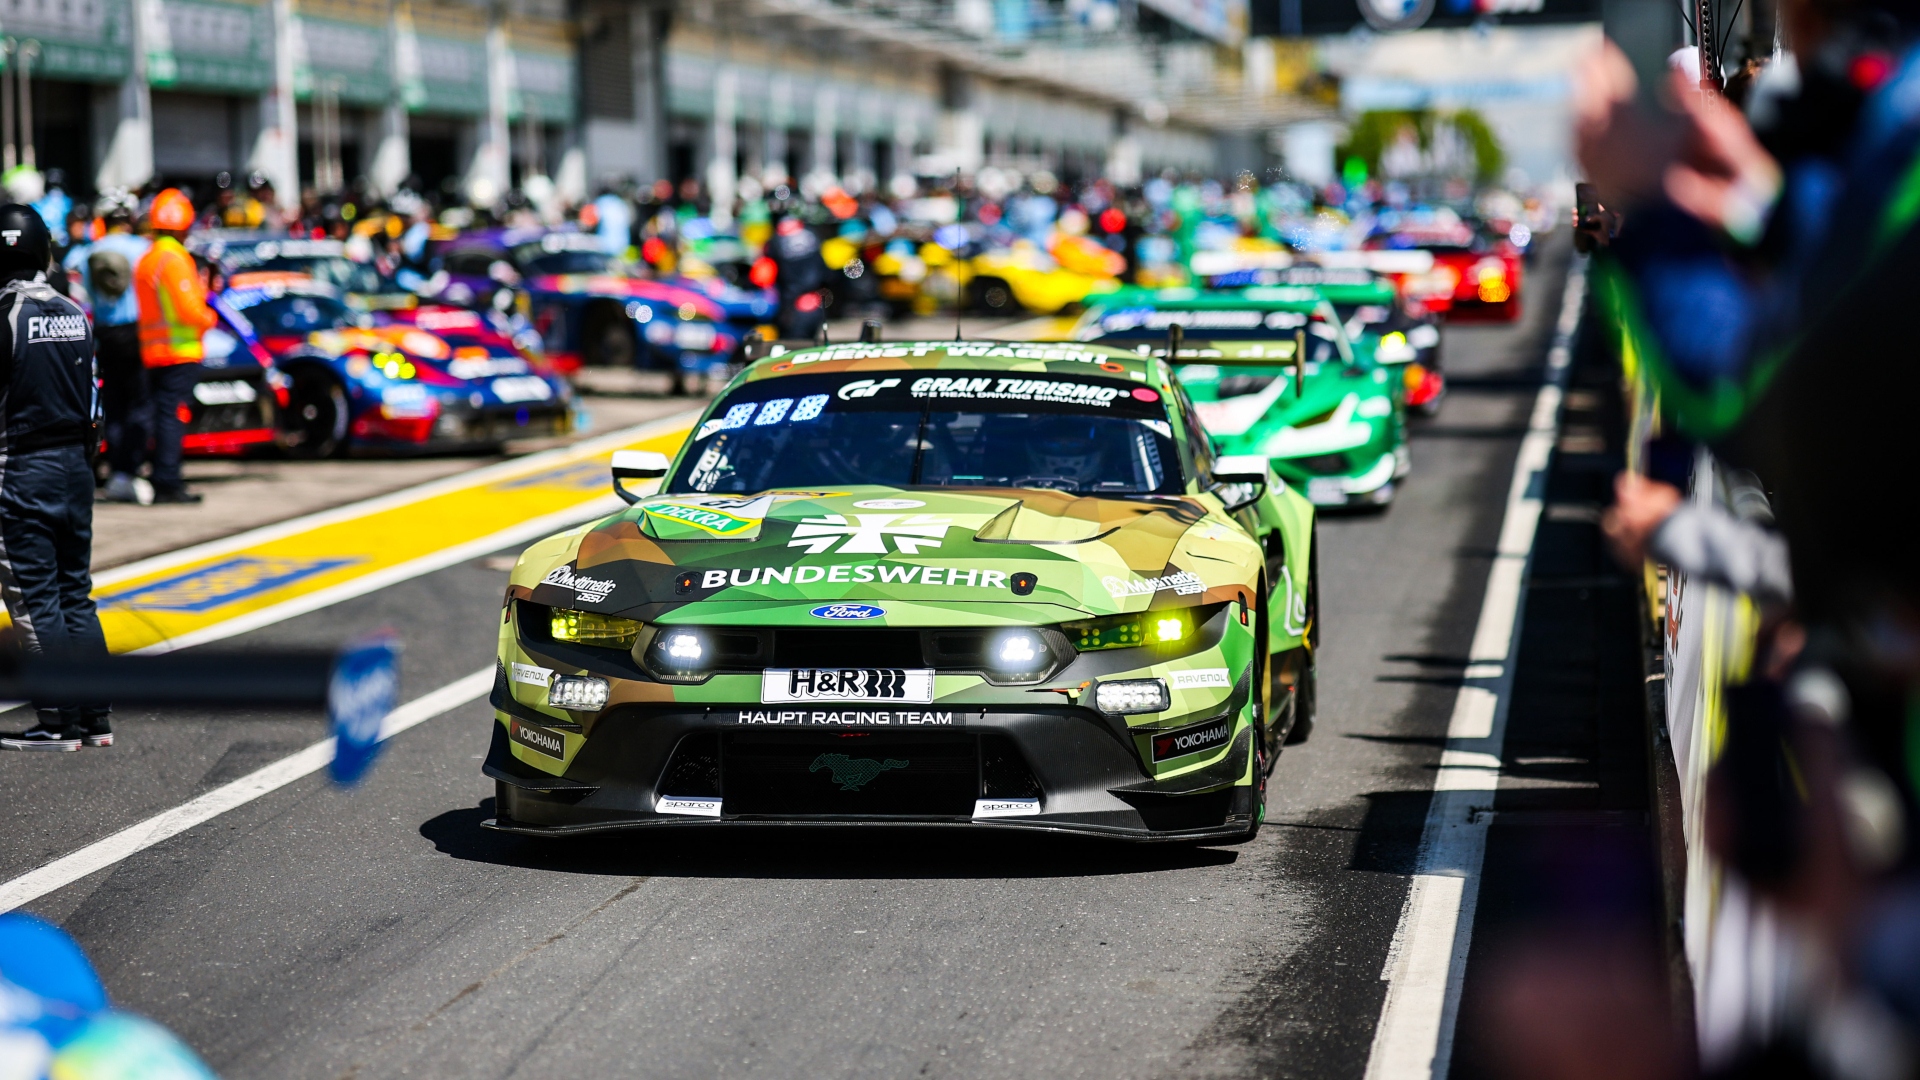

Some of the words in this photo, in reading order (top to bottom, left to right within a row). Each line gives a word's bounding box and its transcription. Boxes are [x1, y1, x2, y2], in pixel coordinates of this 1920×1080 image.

[28, 316, 48, 339] FK
[791, 347, 936, 364] DIENST
[946, 347, 1108, 365] WAGEN!
[910, 377, 992, 392] GRAN
[976, 391, 1032, 400] DRIVING
[1033, 394, 1111, 407] SIMULATOR
[660, 505, 733, 531] DEKRA
[701, 564, 1007, 589] BUNDESWEHR
[1122, 570, 1201, 594] Multimatic
[823, 604, 871, 618] Ford
[789, 669, 863, 697] H&R
[1177, 673, 1226, 684] RAVENOL
[738, 711, 807, 725] HAUPT
[811, 711, 890, 725] RACING
[894, 711, 952, 725] TEAM
[519, 725, 561, 753] YOKOHAMA
[1174, 724, 1229, 750] YOKOHAMA
